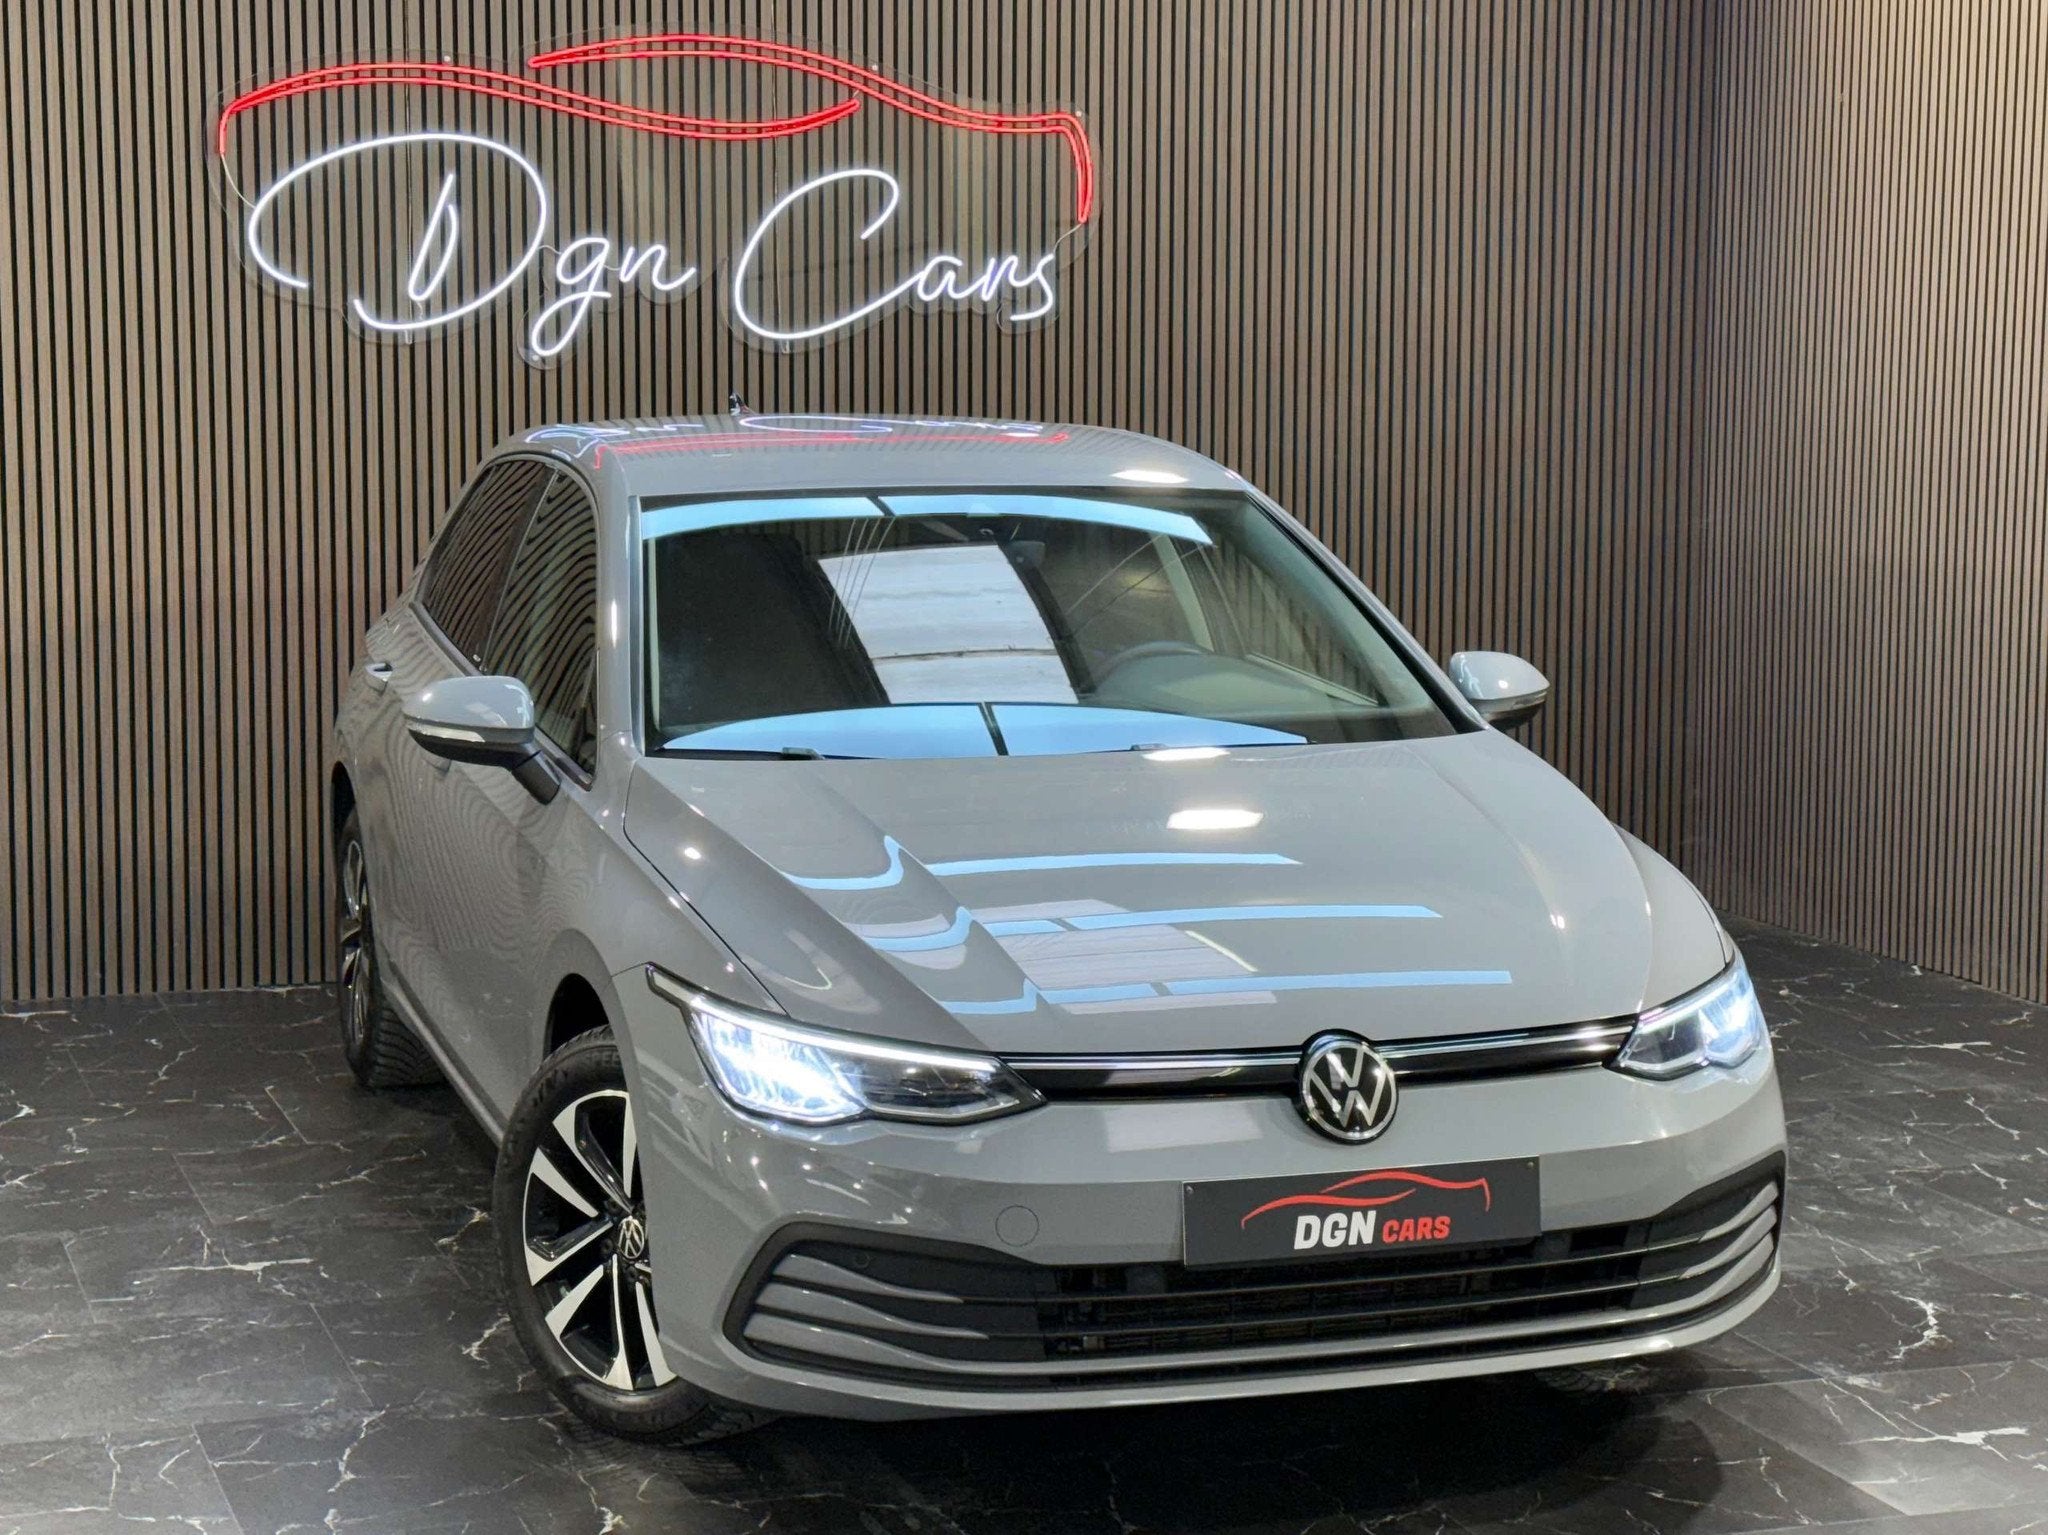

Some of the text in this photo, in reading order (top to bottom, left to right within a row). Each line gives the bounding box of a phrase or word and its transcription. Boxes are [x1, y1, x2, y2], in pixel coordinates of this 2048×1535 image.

[247, 132, 1056, 358] Dgn Cars
[1293, 1210, 1452, 1250] DGN CARS
